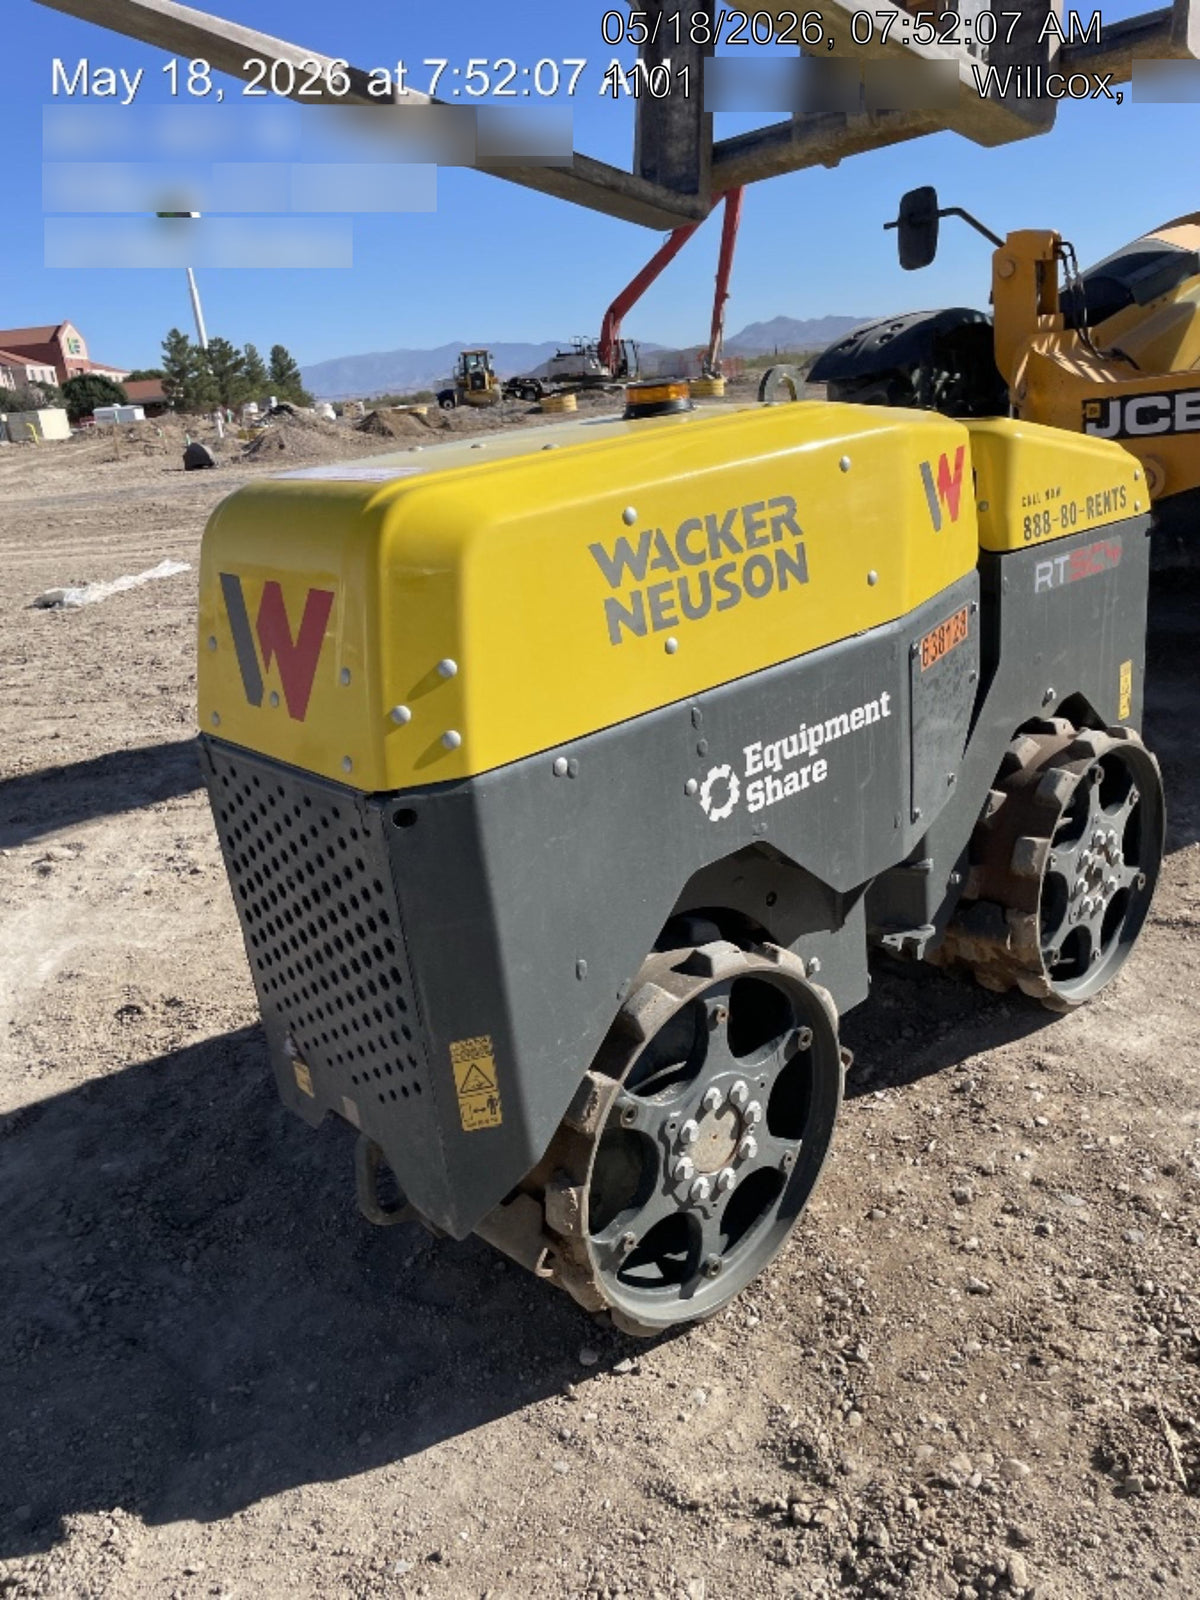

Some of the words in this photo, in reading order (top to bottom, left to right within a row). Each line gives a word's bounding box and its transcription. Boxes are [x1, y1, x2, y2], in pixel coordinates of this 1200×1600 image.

[588, 495, 804, 590] WACKER
[1023, 485, 1127, 541] 888-80-RENTS
[603, 541, 809, 646] NEUSON
[743, 691, 891, 777] Equipment
[745, 758, 828, 814] Share
